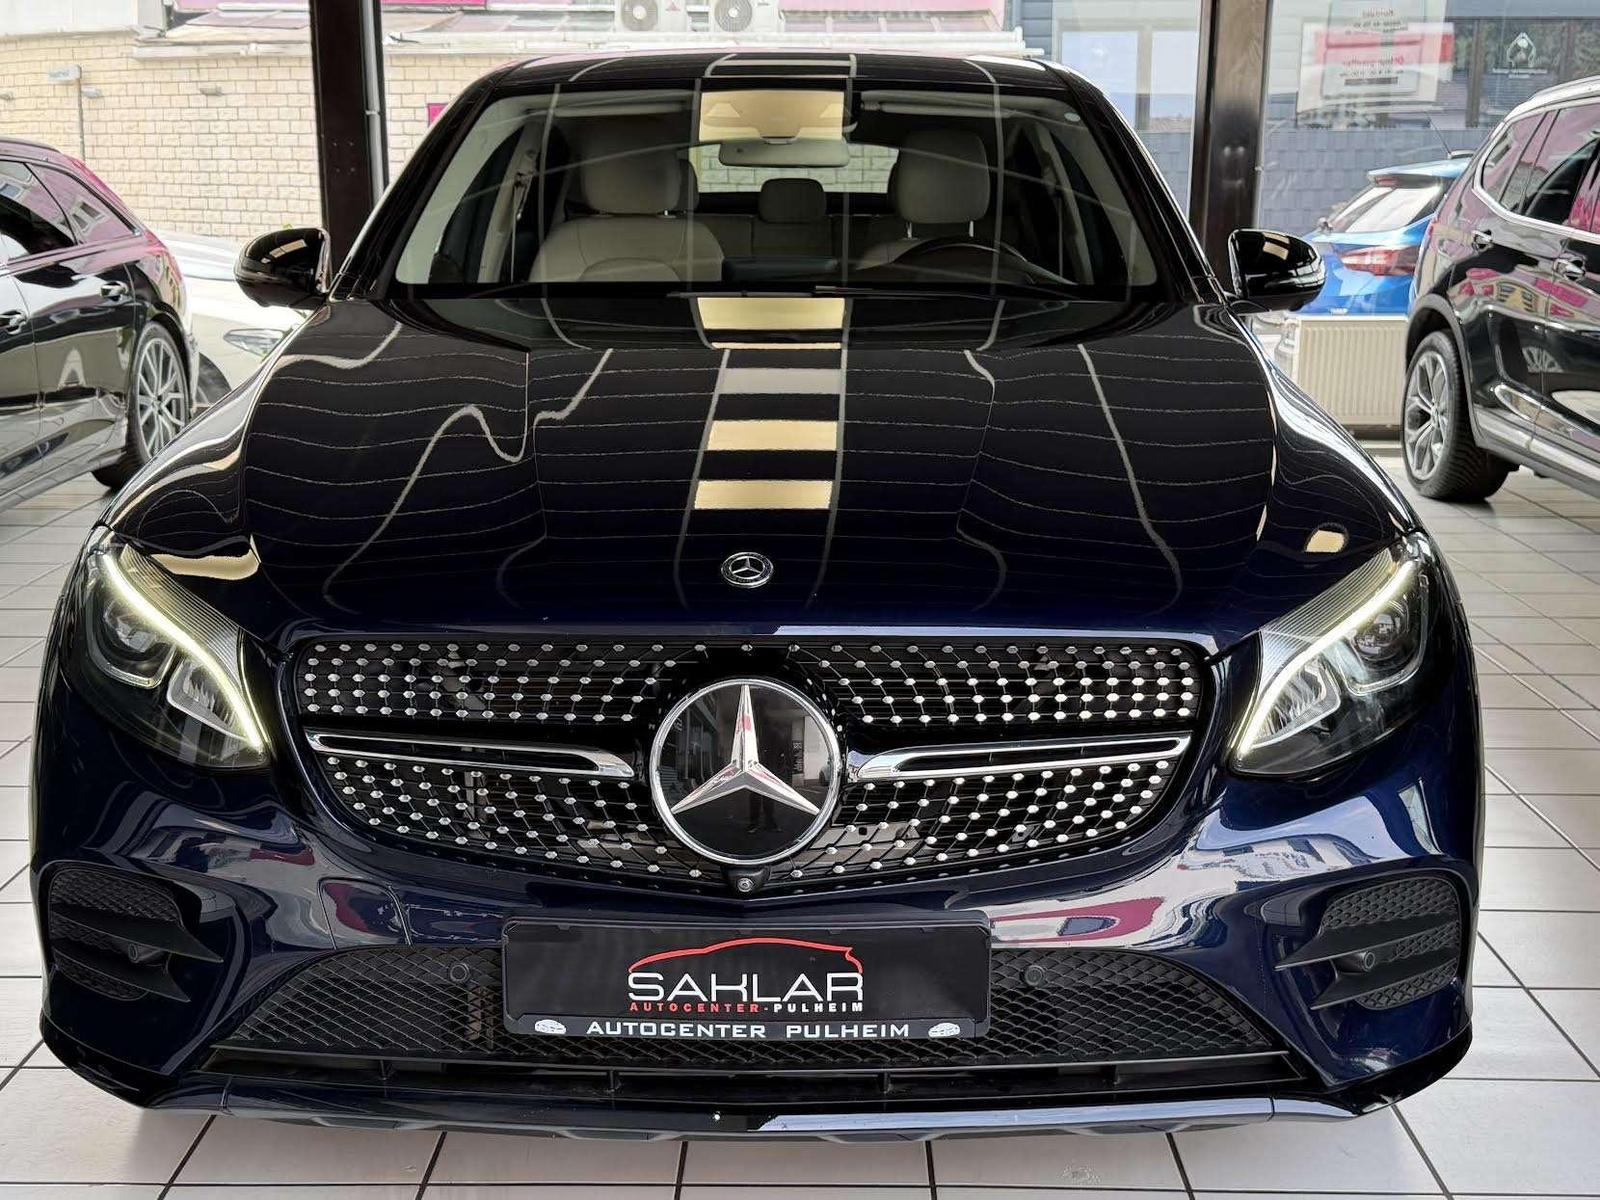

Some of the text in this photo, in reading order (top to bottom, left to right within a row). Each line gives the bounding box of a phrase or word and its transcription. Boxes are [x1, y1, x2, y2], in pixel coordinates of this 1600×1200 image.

[627, 972, 864, 1002] SAKLAR
[629, 1002, 863, 1013] AUTOCENTER-PULHEIM
[586, 1021, 910, 1039] AUTOCENTER PULHEIM
